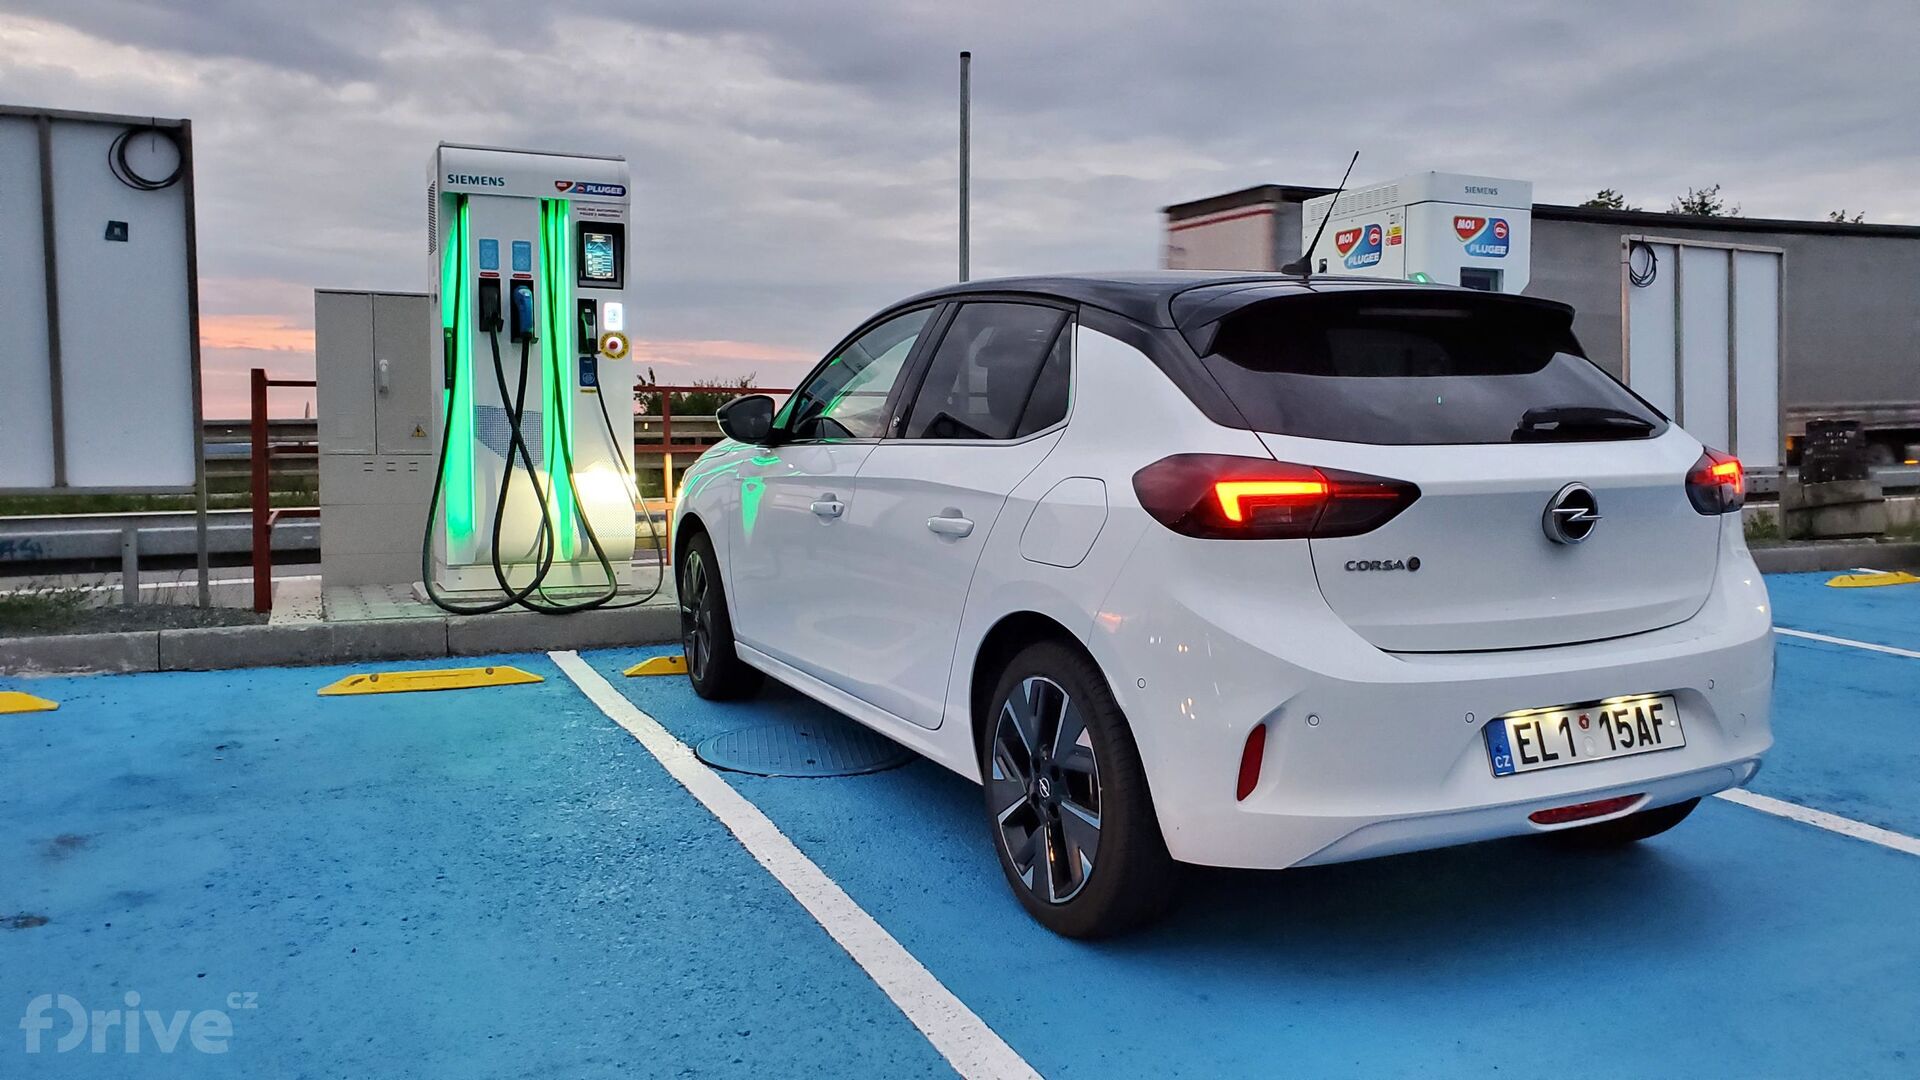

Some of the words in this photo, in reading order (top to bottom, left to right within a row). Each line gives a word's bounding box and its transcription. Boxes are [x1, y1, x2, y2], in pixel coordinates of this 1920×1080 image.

[447, 174, 505, 187] SIEMENS
[586, 184, 624, 195] PLUGEE
[1464, 186, 1498, 196] SIEMENS
[1470, 244, 1508, 255] PLUGEE
[1347, 251, 1380, 267] PLUGEE
[1344, 559, 1406, 572] CORSA
[1512, 716, 1577, 765] EL1
[1598, 702, 1664, 751] 15AF
[1494, 755, 1512, 769] CZ
